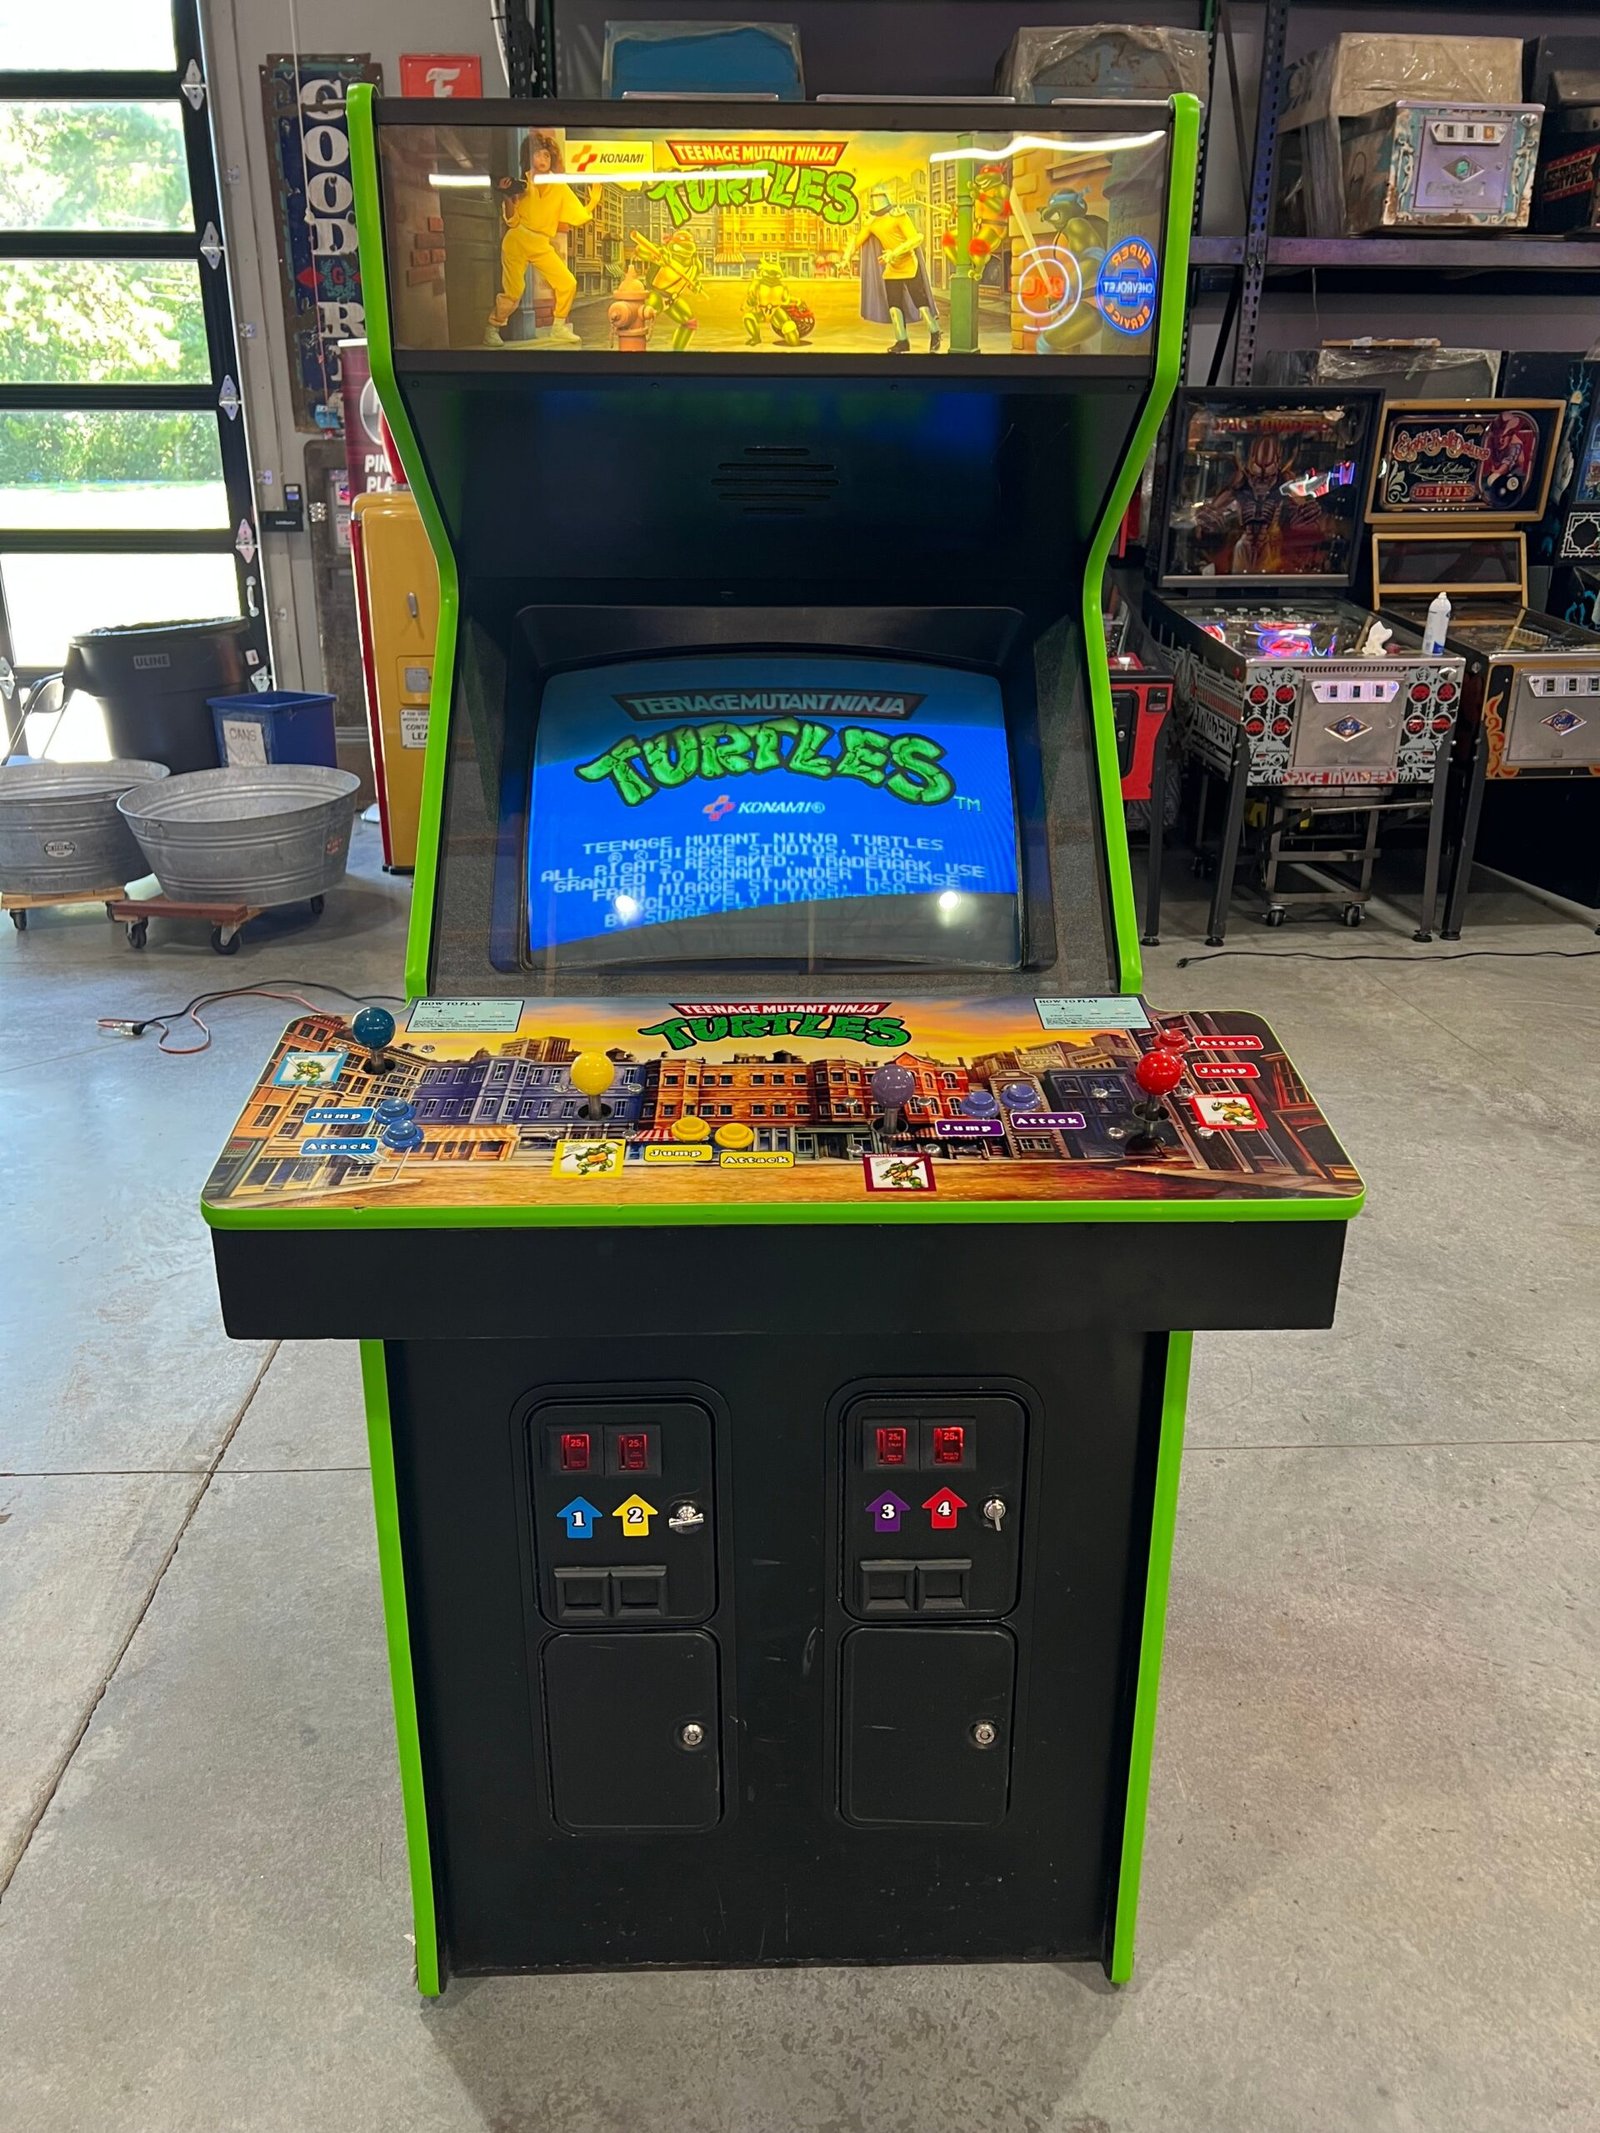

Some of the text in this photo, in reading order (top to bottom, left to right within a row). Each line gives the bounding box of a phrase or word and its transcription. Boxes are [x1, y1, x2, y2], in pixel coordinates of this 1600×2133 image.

[600, 153, 644, 164] KONAMI
[675, 145, 837, 162] TEENAGE MUTANT NINJA
[647, 159, 859, 228] TURTLES
[1415, 486, 1473, 497] DELUXE
[135, 654, 168, 668] ULINE
[626, 694, 905, 715] TEENAGE MUTANT NINJA
[229, 727, 257, 742] CANS
[574, 715, 957, 807] TURTLES
[1283, 771, 1397, 784] SPACE INVADERS
[954, 796, 982, 812] TM
[583, 833, 944, 855] TEENAGE MUTANT NINJA TURTLES
[660, 844, 735, 860] MIRAGE
[541, 868, 580, 883] ALL
[594, 859, 671, 879] RIGHTS
[814, 854, 932, 873] TRADEMARK
[945, 863, 985, 879] USE
[554, 867, 961, 894] GRANTED TO KONAMI UNDER LICENSE
[593, 886, 646, 902] FROM
[659, 880, 735, 896] MIRAGE
[630, 891, 760, 913] XCLUSIVELY
[680, 1004, 879, 1015] TEENAGE MUTANT NINJA
[638, 1012, 911, 1050] TURTLES
[1200, 1067, 1247, 1075] Jump
[311, 1112, 363, 1120] Jump
[1016, 1116, 1079, 1125] Attack
[942, 1123, 992, 1133] Jump
[305, 1143, 371, 1151] Attack
[649, 1148, 703, 1158] Jump
[723, 1155, 790, 1164] Attack
[628, 1507, 643, 1523] 2
[881, 1504, 895, 1519] 3
[937, 1501, 951, 1516] 4
[572, 1511, 586, 1527] 1
